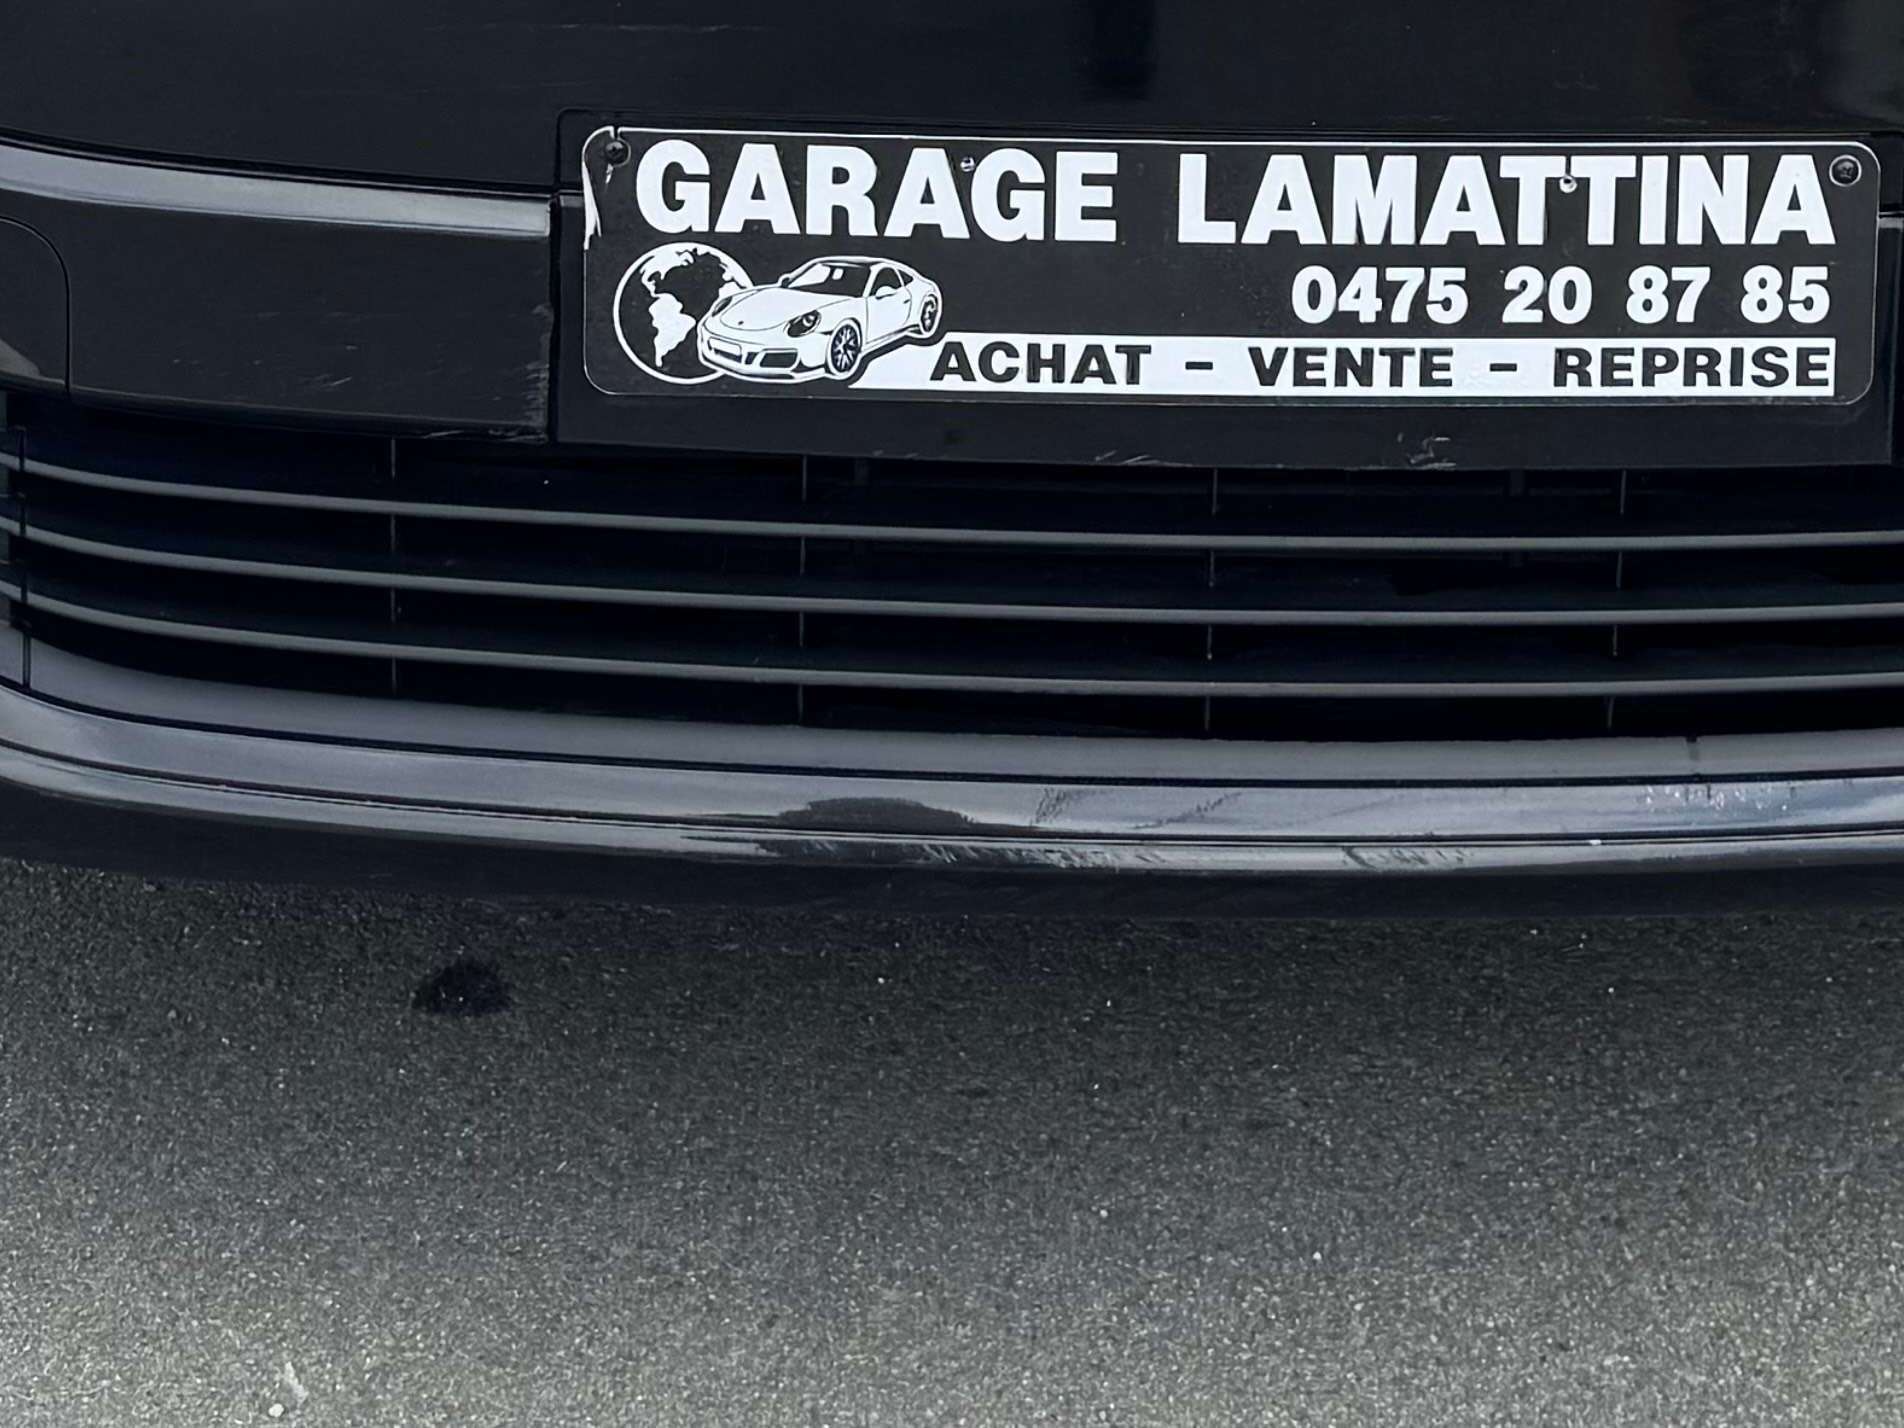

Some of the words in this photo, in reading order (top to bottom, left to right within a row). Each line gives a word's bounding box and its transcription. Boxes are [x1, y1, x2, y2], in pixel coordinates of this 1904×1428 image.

[635, 139, 1119, 243] GARAGE
[1177, 152, 1836, 246] LAMATTINA
[1290, 265, 1469, 325] 0475
[1499, 265, 1593, 325] 20
[1625, 265, 1712, 325] 87
[1740, 265, 1832, 325] 85
[929, 342, 1152, 386] ACHAT
[1247, 346, 1455, 389] VENTE
[1552, 346, 1832, 389] REPRISE
